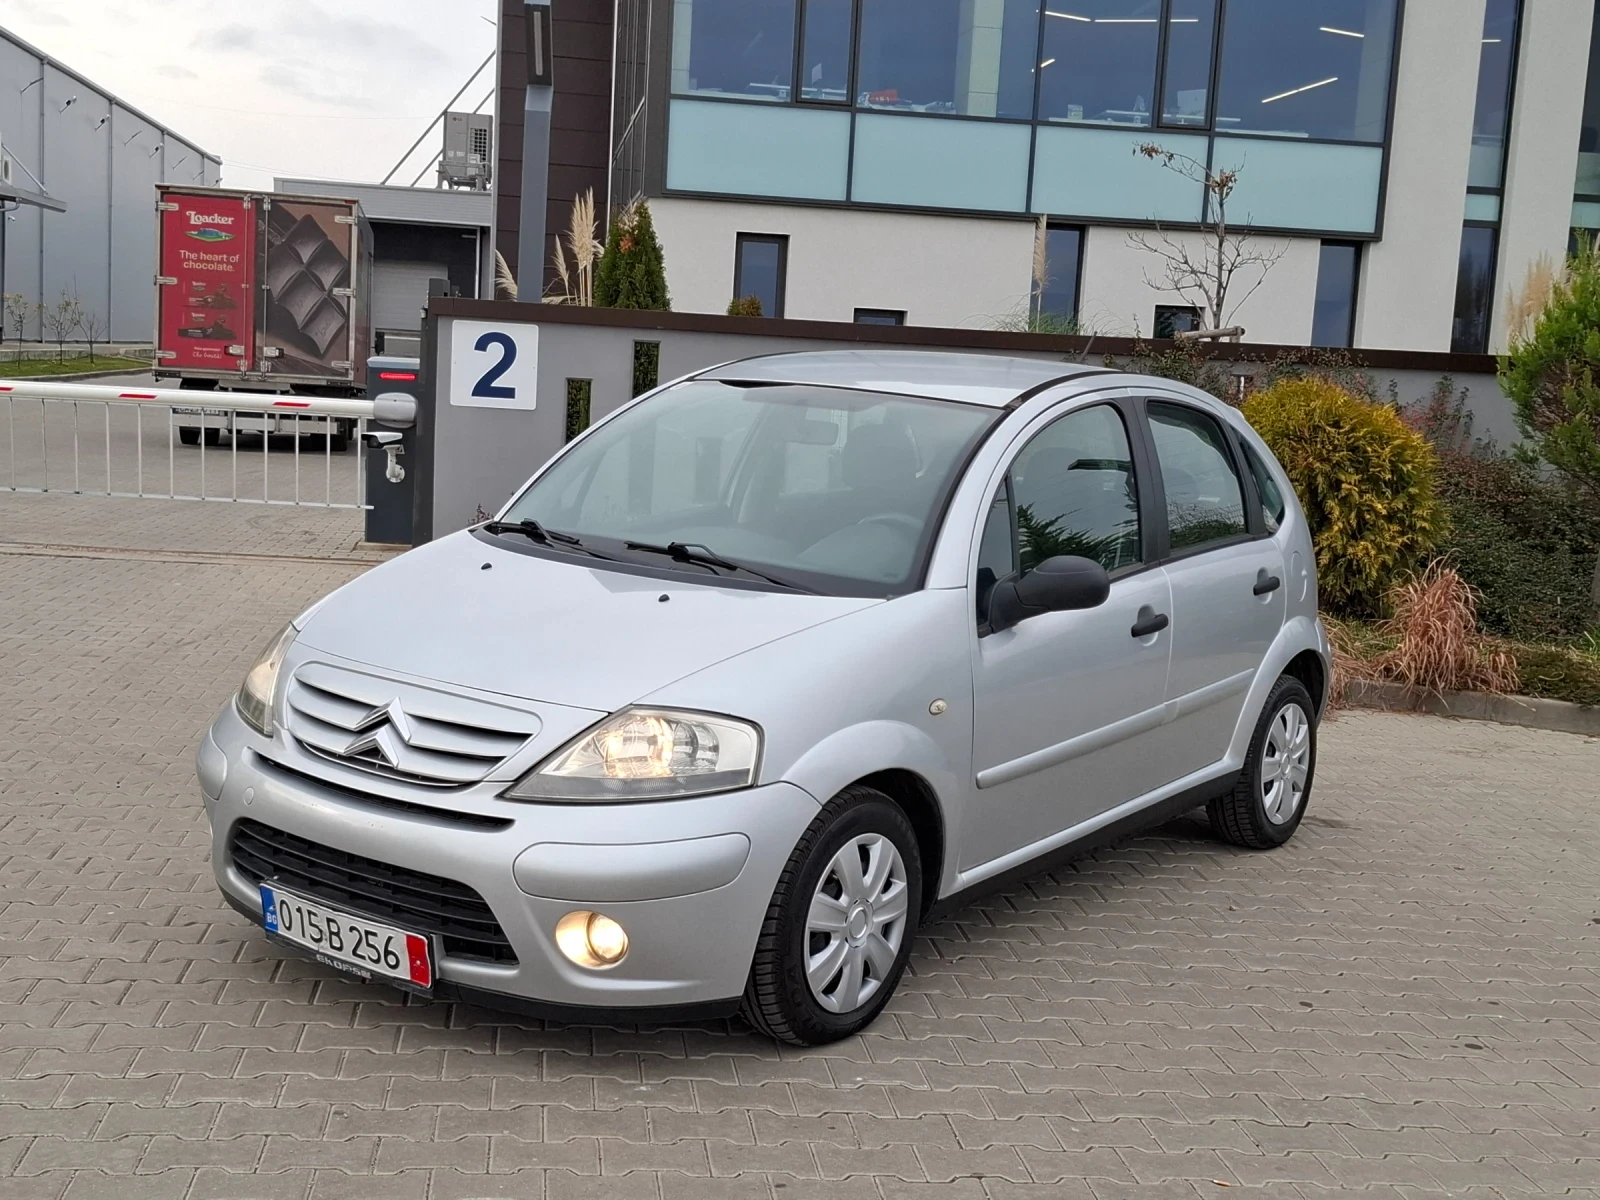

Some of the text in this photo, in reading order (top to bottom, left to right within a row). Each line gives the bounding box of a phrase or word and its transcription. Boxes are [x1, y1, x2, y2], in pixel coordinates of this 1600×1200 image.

[186, 211, 234, 225] Loacker
[179, 250, 240, 263] The heart of
[183, 260, 235, 272] chocolate.
[471, 331, 518, 399] 2
[267, 912, 277, 925] BG
